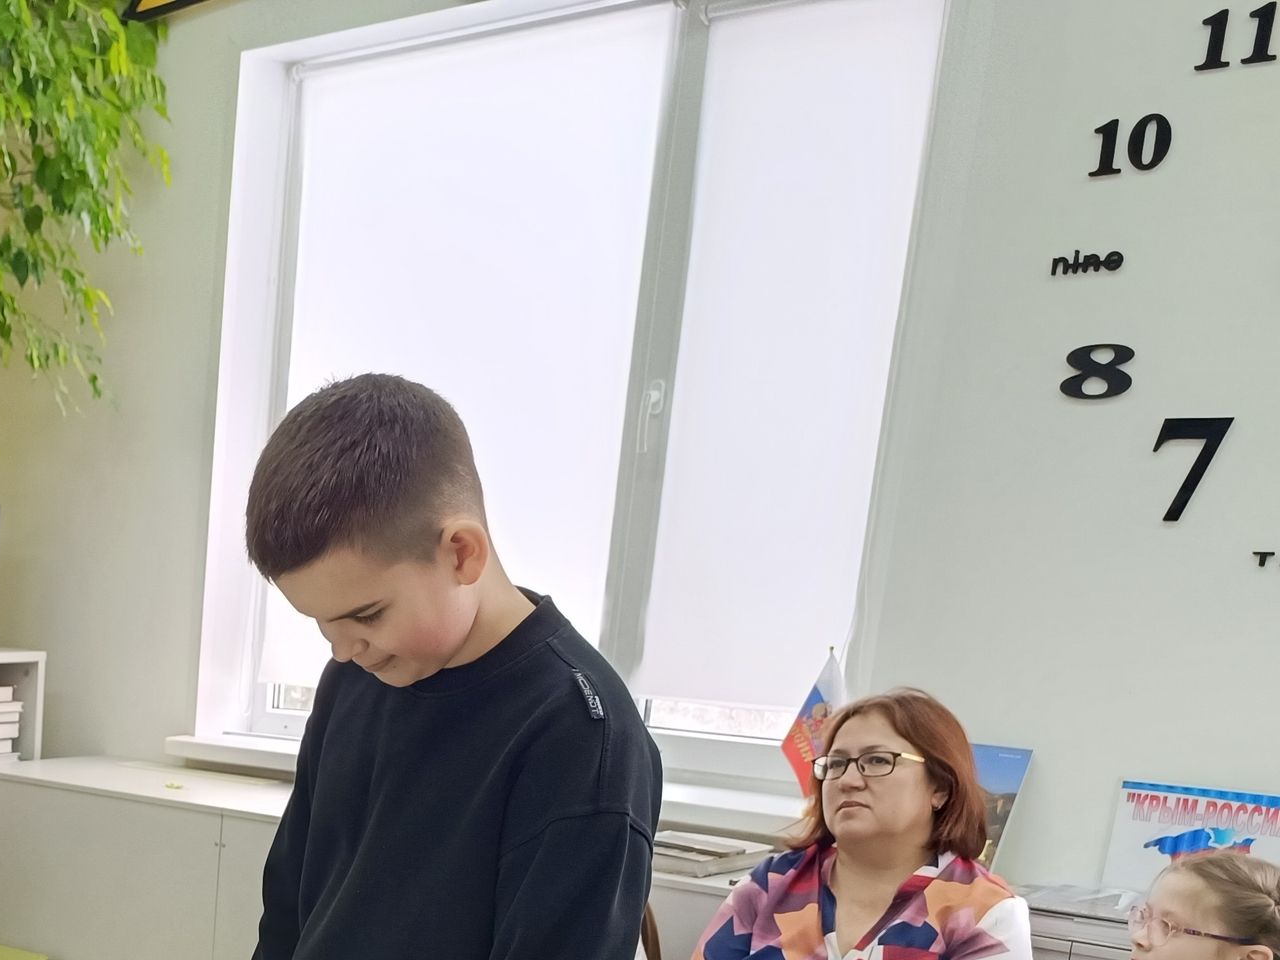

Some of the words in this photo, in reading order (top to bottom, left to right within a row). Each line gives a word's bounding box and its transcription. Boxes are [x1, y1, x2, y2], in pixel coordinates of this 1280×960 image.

[1194, 1, 1278, 71] 11
[1088, 113, 1172, 177] 10
[1060, 343, 1135, 400] 8
[1152, 417, 1235, 521] 7
